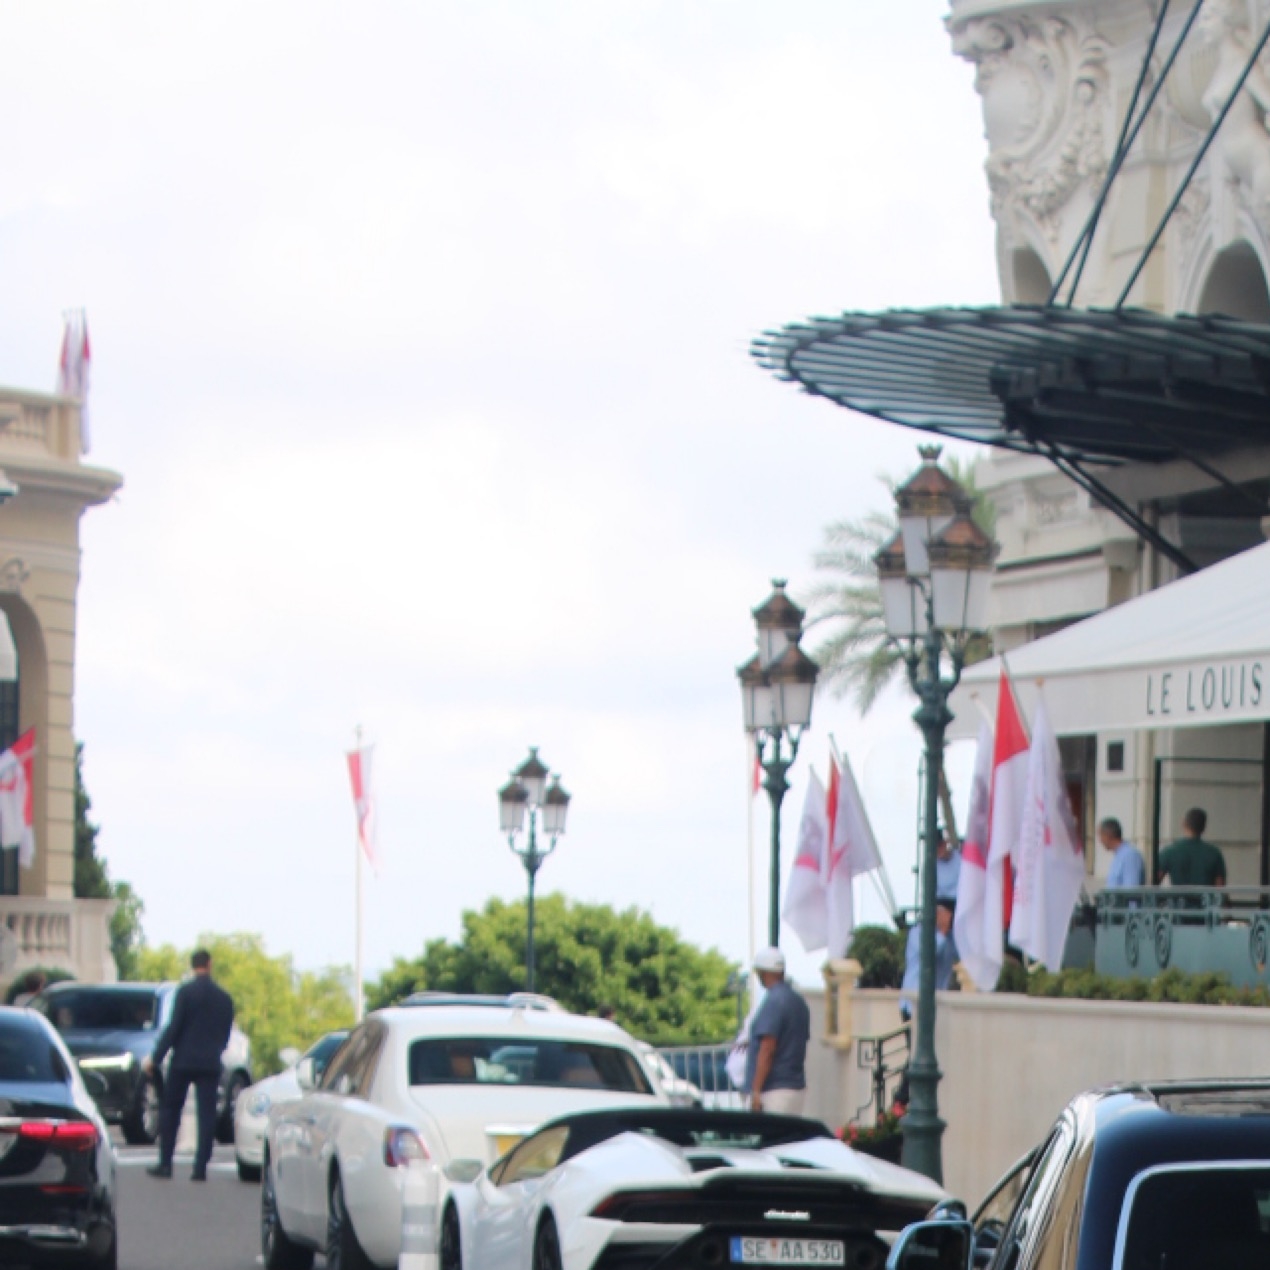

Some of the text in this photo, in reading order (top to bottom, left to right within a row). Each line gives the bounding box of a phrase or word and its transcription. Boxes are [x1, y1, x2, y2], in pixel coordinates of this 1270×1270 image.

[1146, 673, 1172, 715] LE
[1186, 661, 1262, 713] LOUIS
[743, 1239, 842, 1261] SE AA 530
